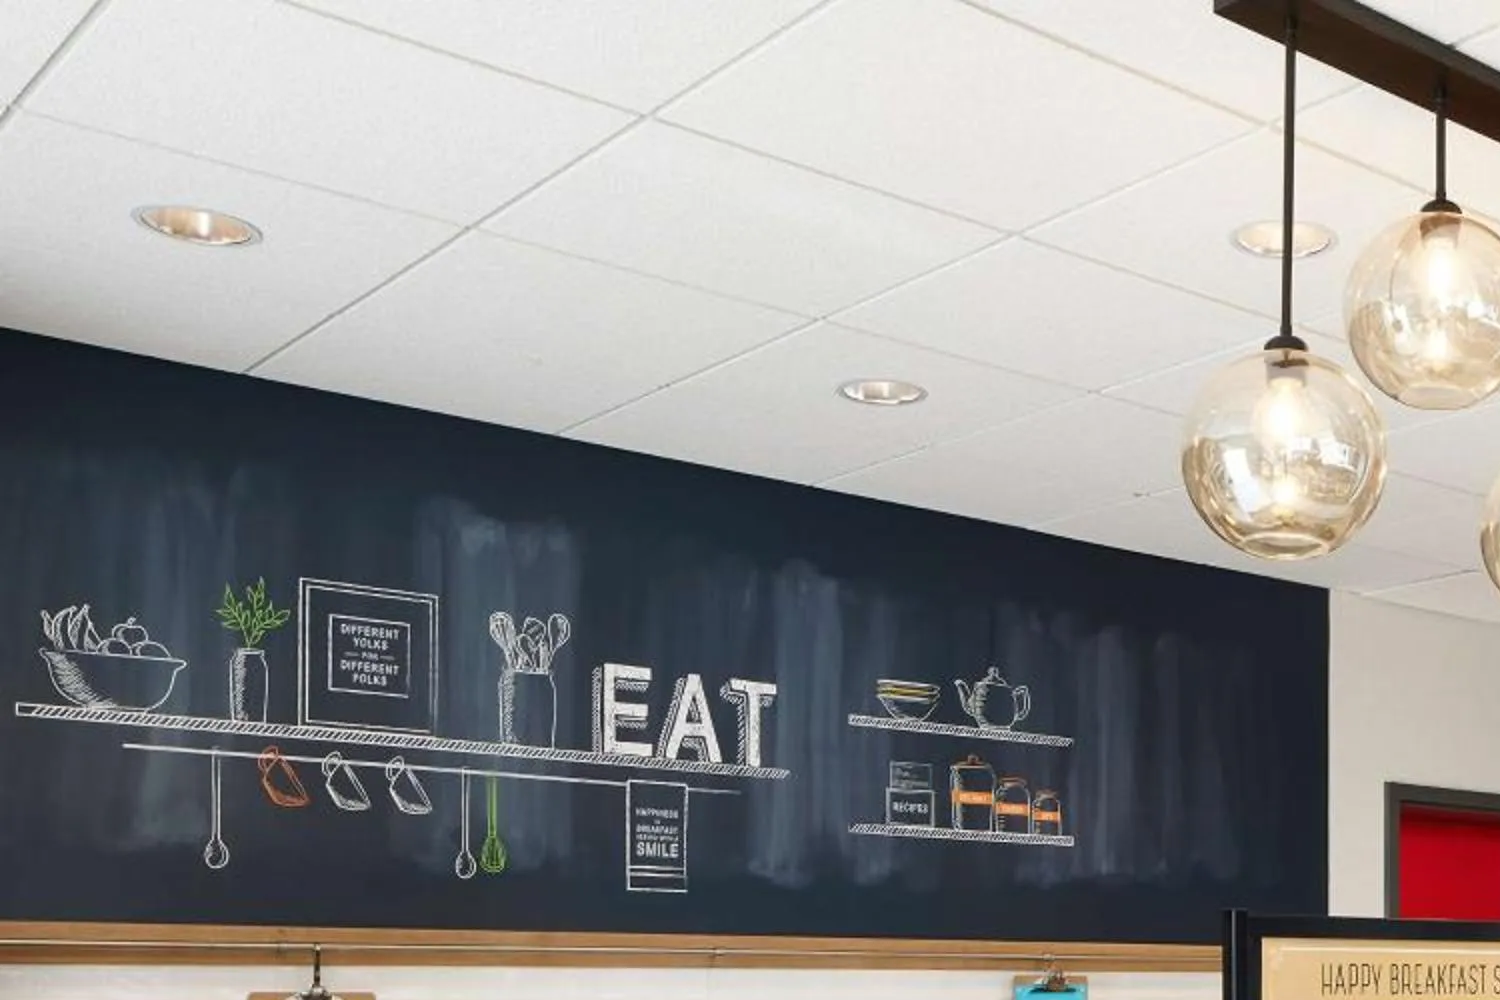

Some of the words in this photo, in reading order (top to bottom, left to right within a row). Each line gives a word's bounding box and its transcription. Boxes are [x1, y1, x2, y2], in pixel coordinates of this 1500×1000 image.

[340, 624, 400, 640] DIFFERENT
[352, 637, 389, 651] YOLKS
[340, 659, 400, 676] DIFFERENT
[353, 673, 387, 686] FOLKS
[592, 662, 777, 768] EAT
[636, 841, 680, 858] SMILE
[1320, 963, 1382, 996] HAPPY
[1389, 963, 1487, 996] BREAKFAST
